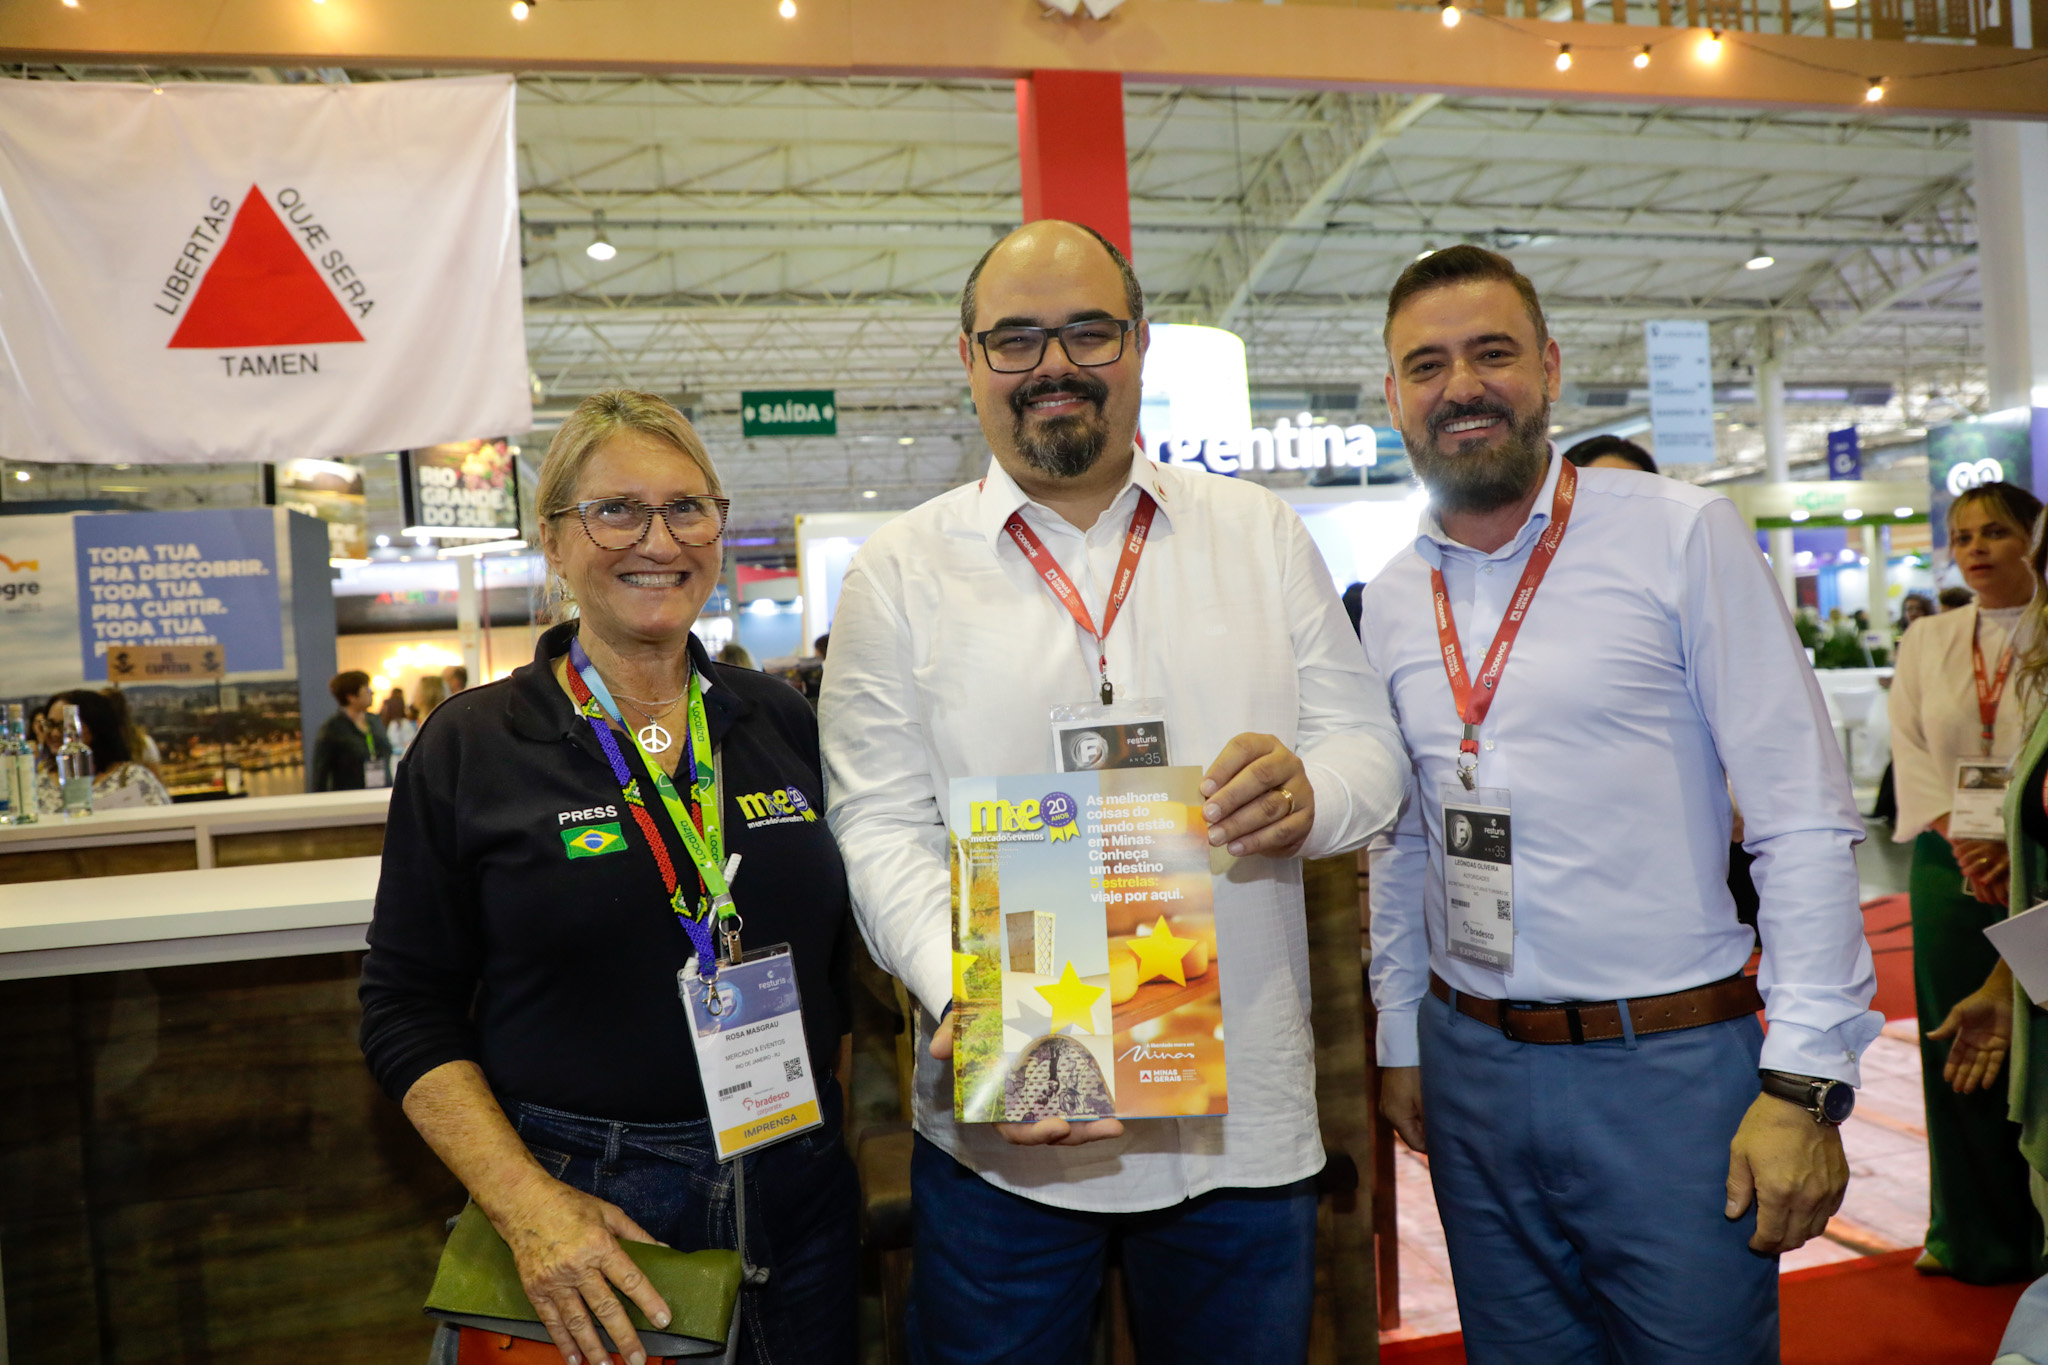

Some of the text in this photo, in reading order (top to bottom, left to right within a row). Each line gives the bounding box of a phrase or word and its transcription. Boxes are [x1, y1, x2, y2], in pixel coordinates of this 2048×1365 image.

[154, 195, 231, 316] LIBERTAS
[277, 187, 375, 319] QUÆ SERA
[219, 352, 320, 377] TAMEN
[758, 399, 822, 424] SAÍDA
[1146, 411, 1378, 474] rgentina
[419, 465, 458, 488] RIO
[421, 486, 506, 510] GRANDE
[422, 505, 497, 528] DO SUL
[1132, 524, 1141, 543] MINAS
[1136, 525, 1147, 545] GERAIS
[1545, 521, 1565, 556] Minas
[87, 543, 202, 565] TODA TUA
[1015, 530, 1039, 558] CODEMGE
[88, 559, 270, 583] PRA DESCOBRIR.
[0, 581, 41, 601] gre
[90, 581, 204, 601] TODA TUA
[1051, 580, 1068, 599] GERAIS
[1055, 577, 1071, 594] MINAS
[1117, 568, 1131, 600] CODEMGE
[1514, 589, 1527, 609] MINAS
[1520, 587, 1534, 610] GERAIS
[91, 597, 229, 621] PRA CURTIR.
[93, 617, 207, 639] TODA TUA
[1446, 656, 1456, 678] GERAIS
[1451, 653, 1460, 673] MINAS
[1489, 641, 1509, 677] CODEMGE
[691, 706, 705, 742] Localiza
[1126, 735, 1158, 745] Festuris
[1144, 752, 1161, 765] 35
[1046, 798, 1068, 815] 20
[1086, 792, 1169, 806] As melhores
[557, 805, 618, 825] PRESS
[969, 799, 1045, 833] m&e
[1051, 812, 1070, 822] ANOS
[1086, 806, 1150, 820] coisas do
[1087, 818, 1175, 834] mundo estão
[1484, 827, 1506, 836] Festuris
[680, 820, 706, 860] Localiza
[970, 832, 1045, 843] mercado&eventos
[1088, 834, 1156, 847] em Minas.
[1088, 848, 1149, 862] Conheça
[1494, 845, 1506, 859] 35
[1089, 861, 1164, 875] um destino
[1477, 862, 1499, 872] OLIVEIRA
[1090, 876, 1159, 889] 5 estrelas:
[1090, 888, 1184, 904] viaje por aqui.
[1469, 928, 1495, 940] bradesco
[1459, 946, 1499, 964] EXPOSITOR
[758, 976, 787, 991] Festuris
[725, 1020, 779, 1041] ROSA MASGRAU
[725, 1047, 754, 1061] MERCADO
[759, 1038, 786, 1051] EVENTOS
[752, 1054, 772, 1065] JANEIRO
[1117, 1045, 1195, 1063] Minas
[755, 1091, 790, 1109] bradesco
[743, 1113, 798, 1139] IMPRENSA
